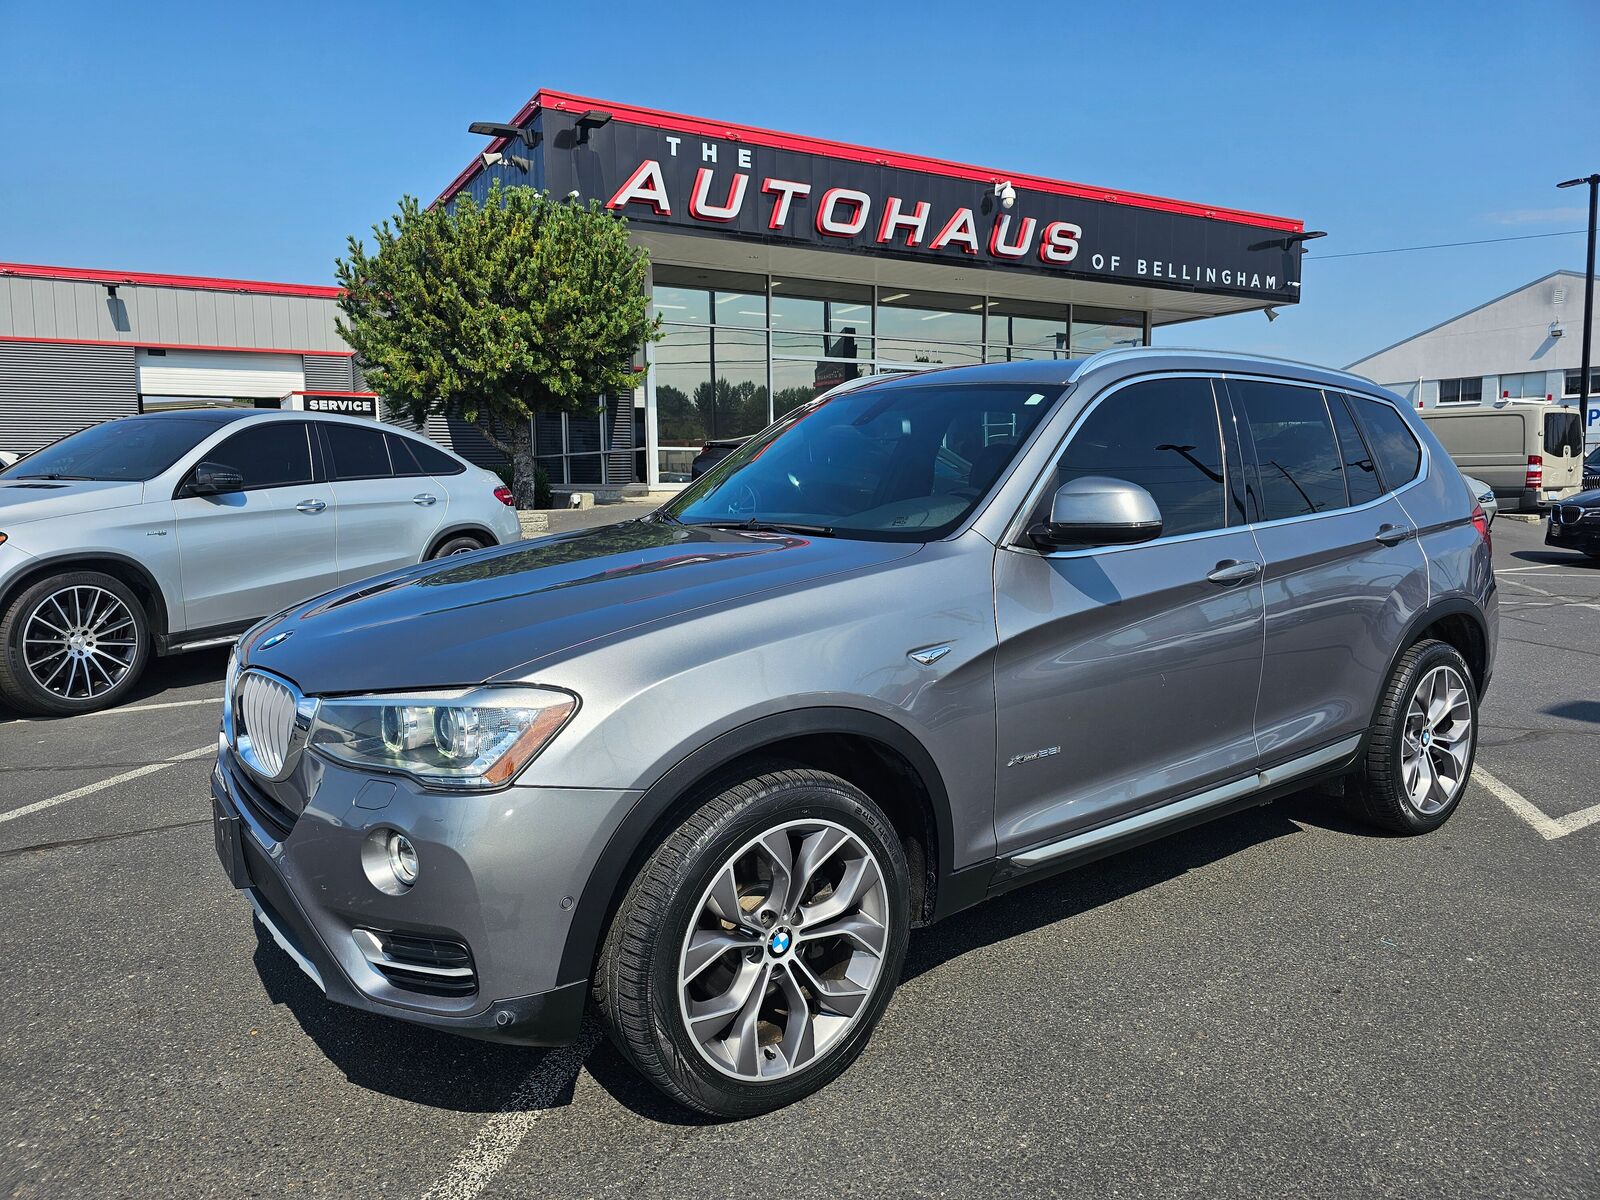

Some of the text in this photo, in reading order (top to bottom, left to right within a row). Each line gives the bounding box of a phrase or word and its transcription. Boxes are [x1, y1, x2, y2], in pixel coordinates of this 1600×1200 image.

[665, 136, 752, 169] THE
[605, 159, 1083, 265] AUTOHAUS
[1092, 253, 1276, 290] OF BELLINGHAM
[309, 400, 372, 412] SERVICE
